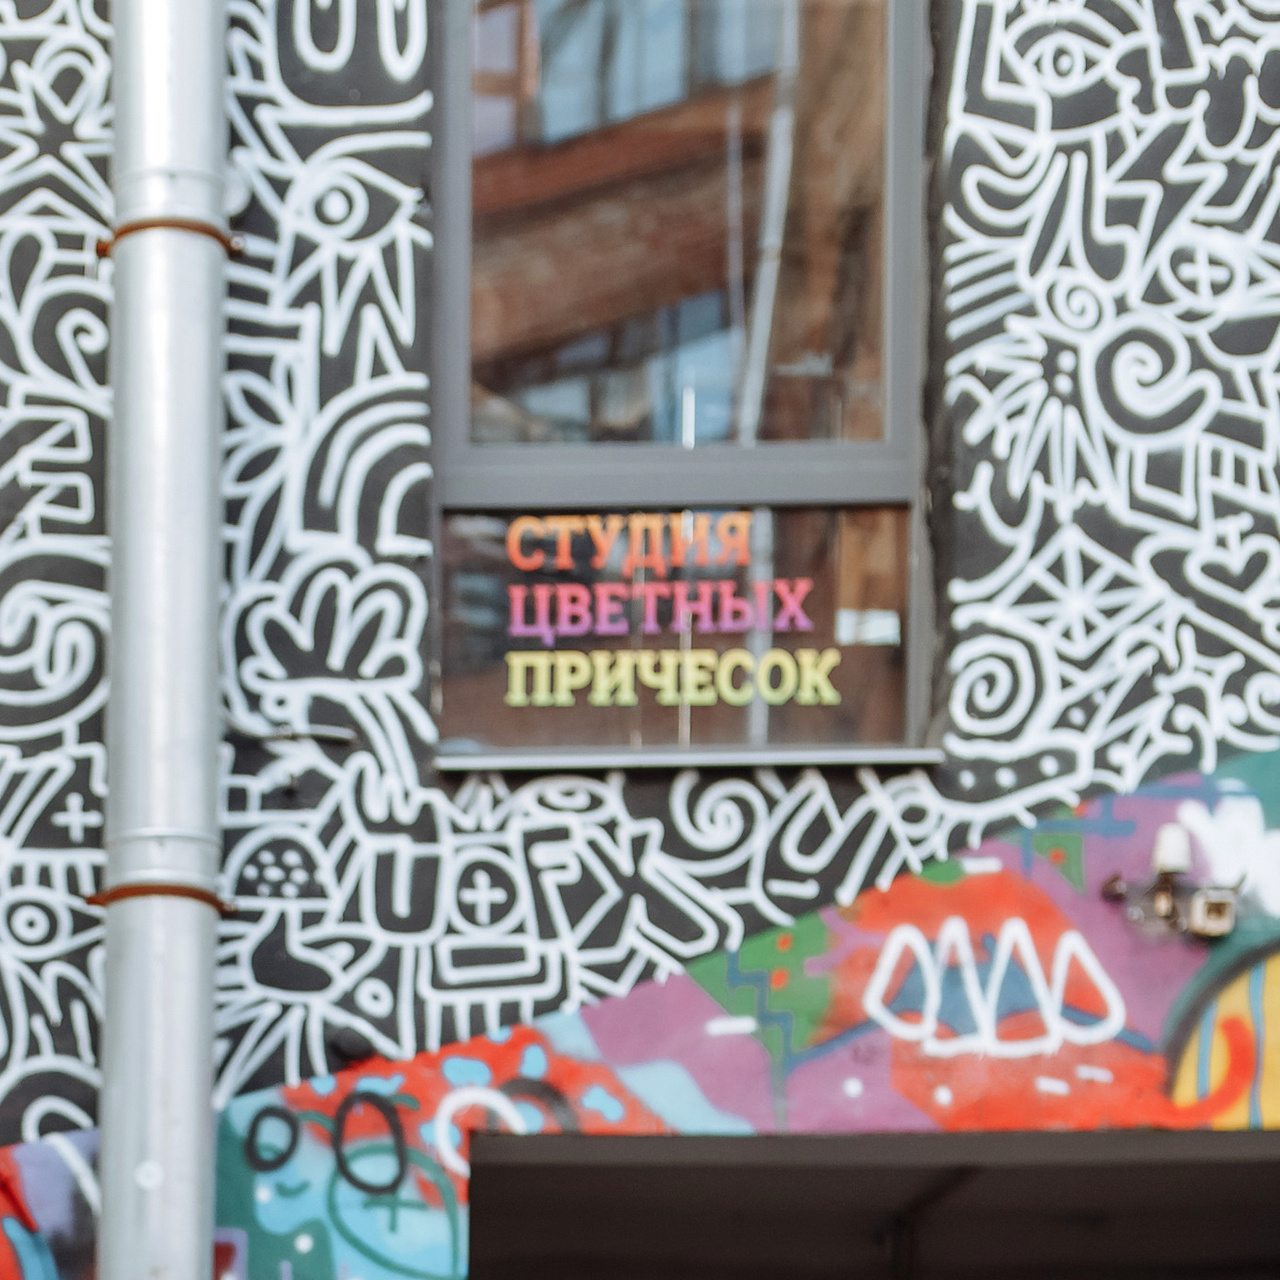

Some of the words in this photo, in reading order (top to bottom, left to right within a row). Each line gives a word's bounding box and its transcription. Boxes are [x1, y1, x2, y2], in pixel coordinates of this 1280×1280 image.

[506, 510, 754, 577] СТУДИЯ
[506, 579, 814, 646] ЦВЕТНЫХ
[505, 647, 842, 706] ПРИЧЕСОК
